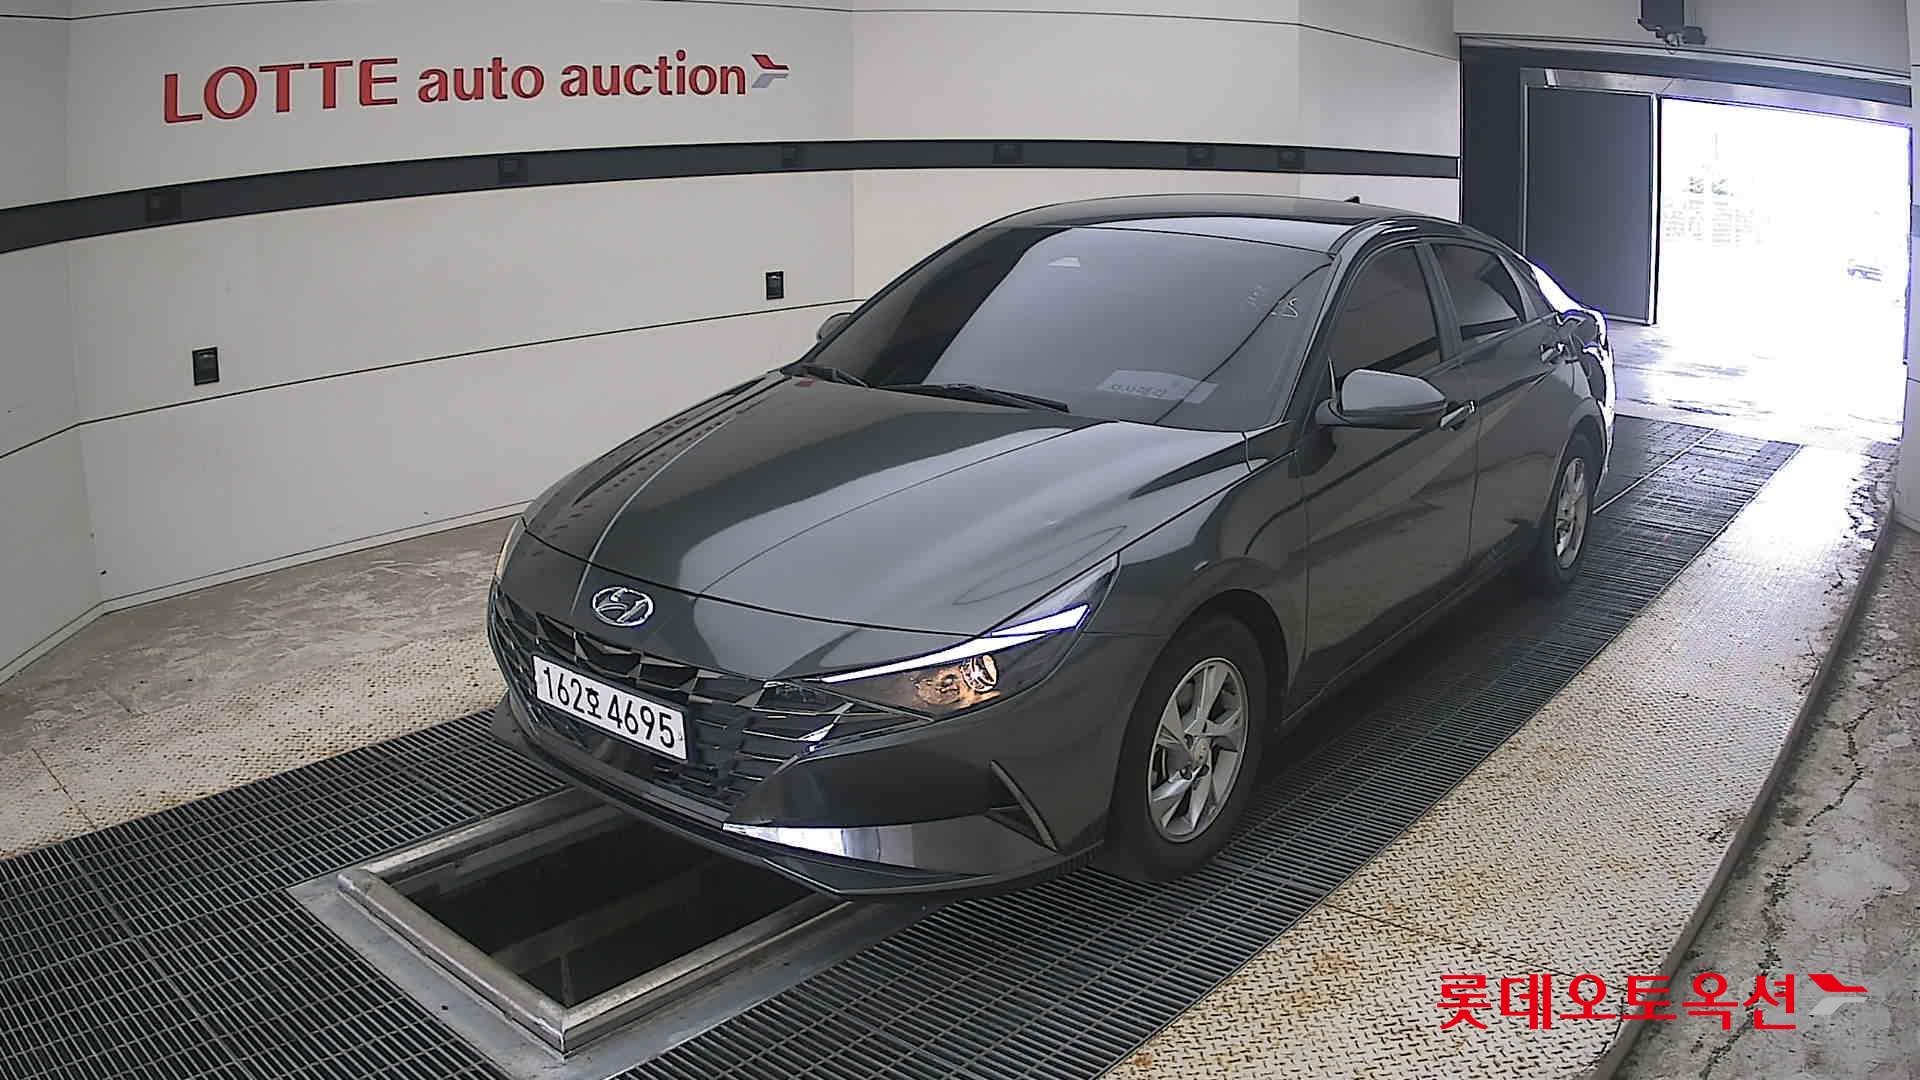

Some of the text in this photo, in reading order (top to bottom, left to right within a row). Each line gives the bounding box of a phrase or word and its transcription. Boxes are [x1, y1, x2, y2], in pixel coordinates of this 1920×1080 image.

[163, 49, 747, 125] LOTTE auto auction
[543, 666, 675, 748] 162호 4695
